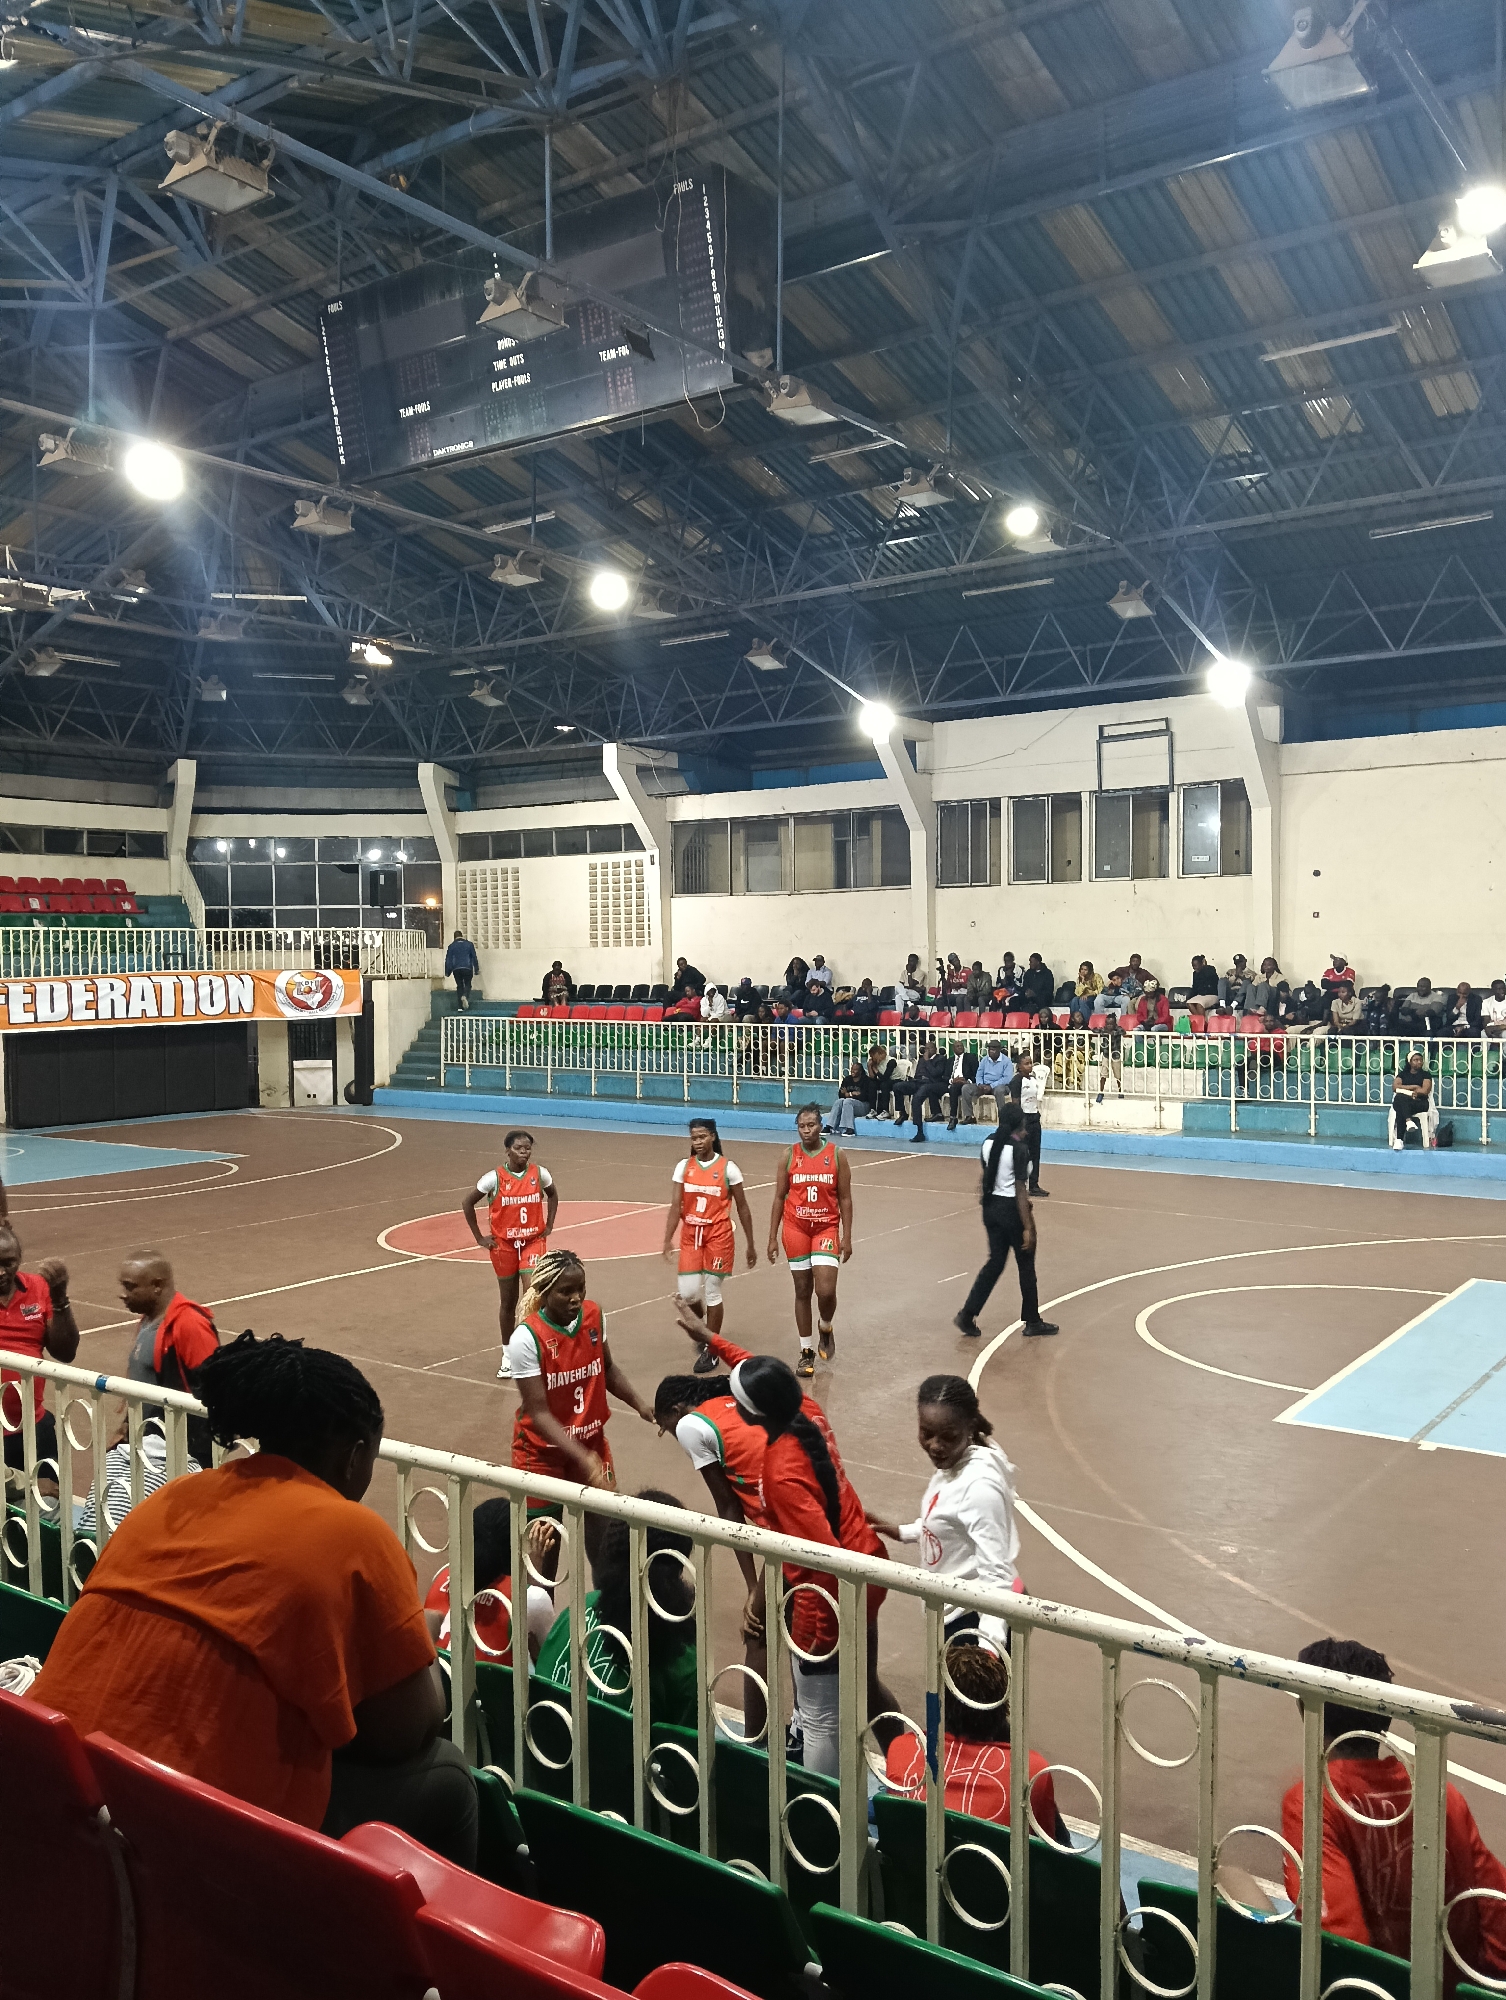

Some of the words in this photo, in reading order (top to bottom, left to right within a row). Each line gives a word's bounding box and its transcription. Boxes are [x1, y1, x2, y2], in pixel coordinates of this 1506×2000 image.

[673, 178, 694, 194] FOULS
[703, 196, 708, 206] 2
[704, 208, 709, 219] 3
[705, 220, 710, 230] 4
[709, 256, 714, 267] 7
[713, 293, 720, 304] 10
[327, 301, 343, 314] FOULS
[715, 317, 723, 328] 12
[717, 329, 724, 340] 13
[493, 358, 507, 371] TIME
[509, 353, 525, 367] OUTS
[491, 372, 531, 392] PLAYER-FOULS
[399, 401, 431, 418] TEAM-FOULS
[433, 441, 474, 456] DAKTRONICS
[792, 1173, 834, 1184] BRAVEHEARTS
[807, 1186, 818, 1202] 16
[520, 1206, 528, 1224] 6
[573, 1386, 585, 1414] 9
